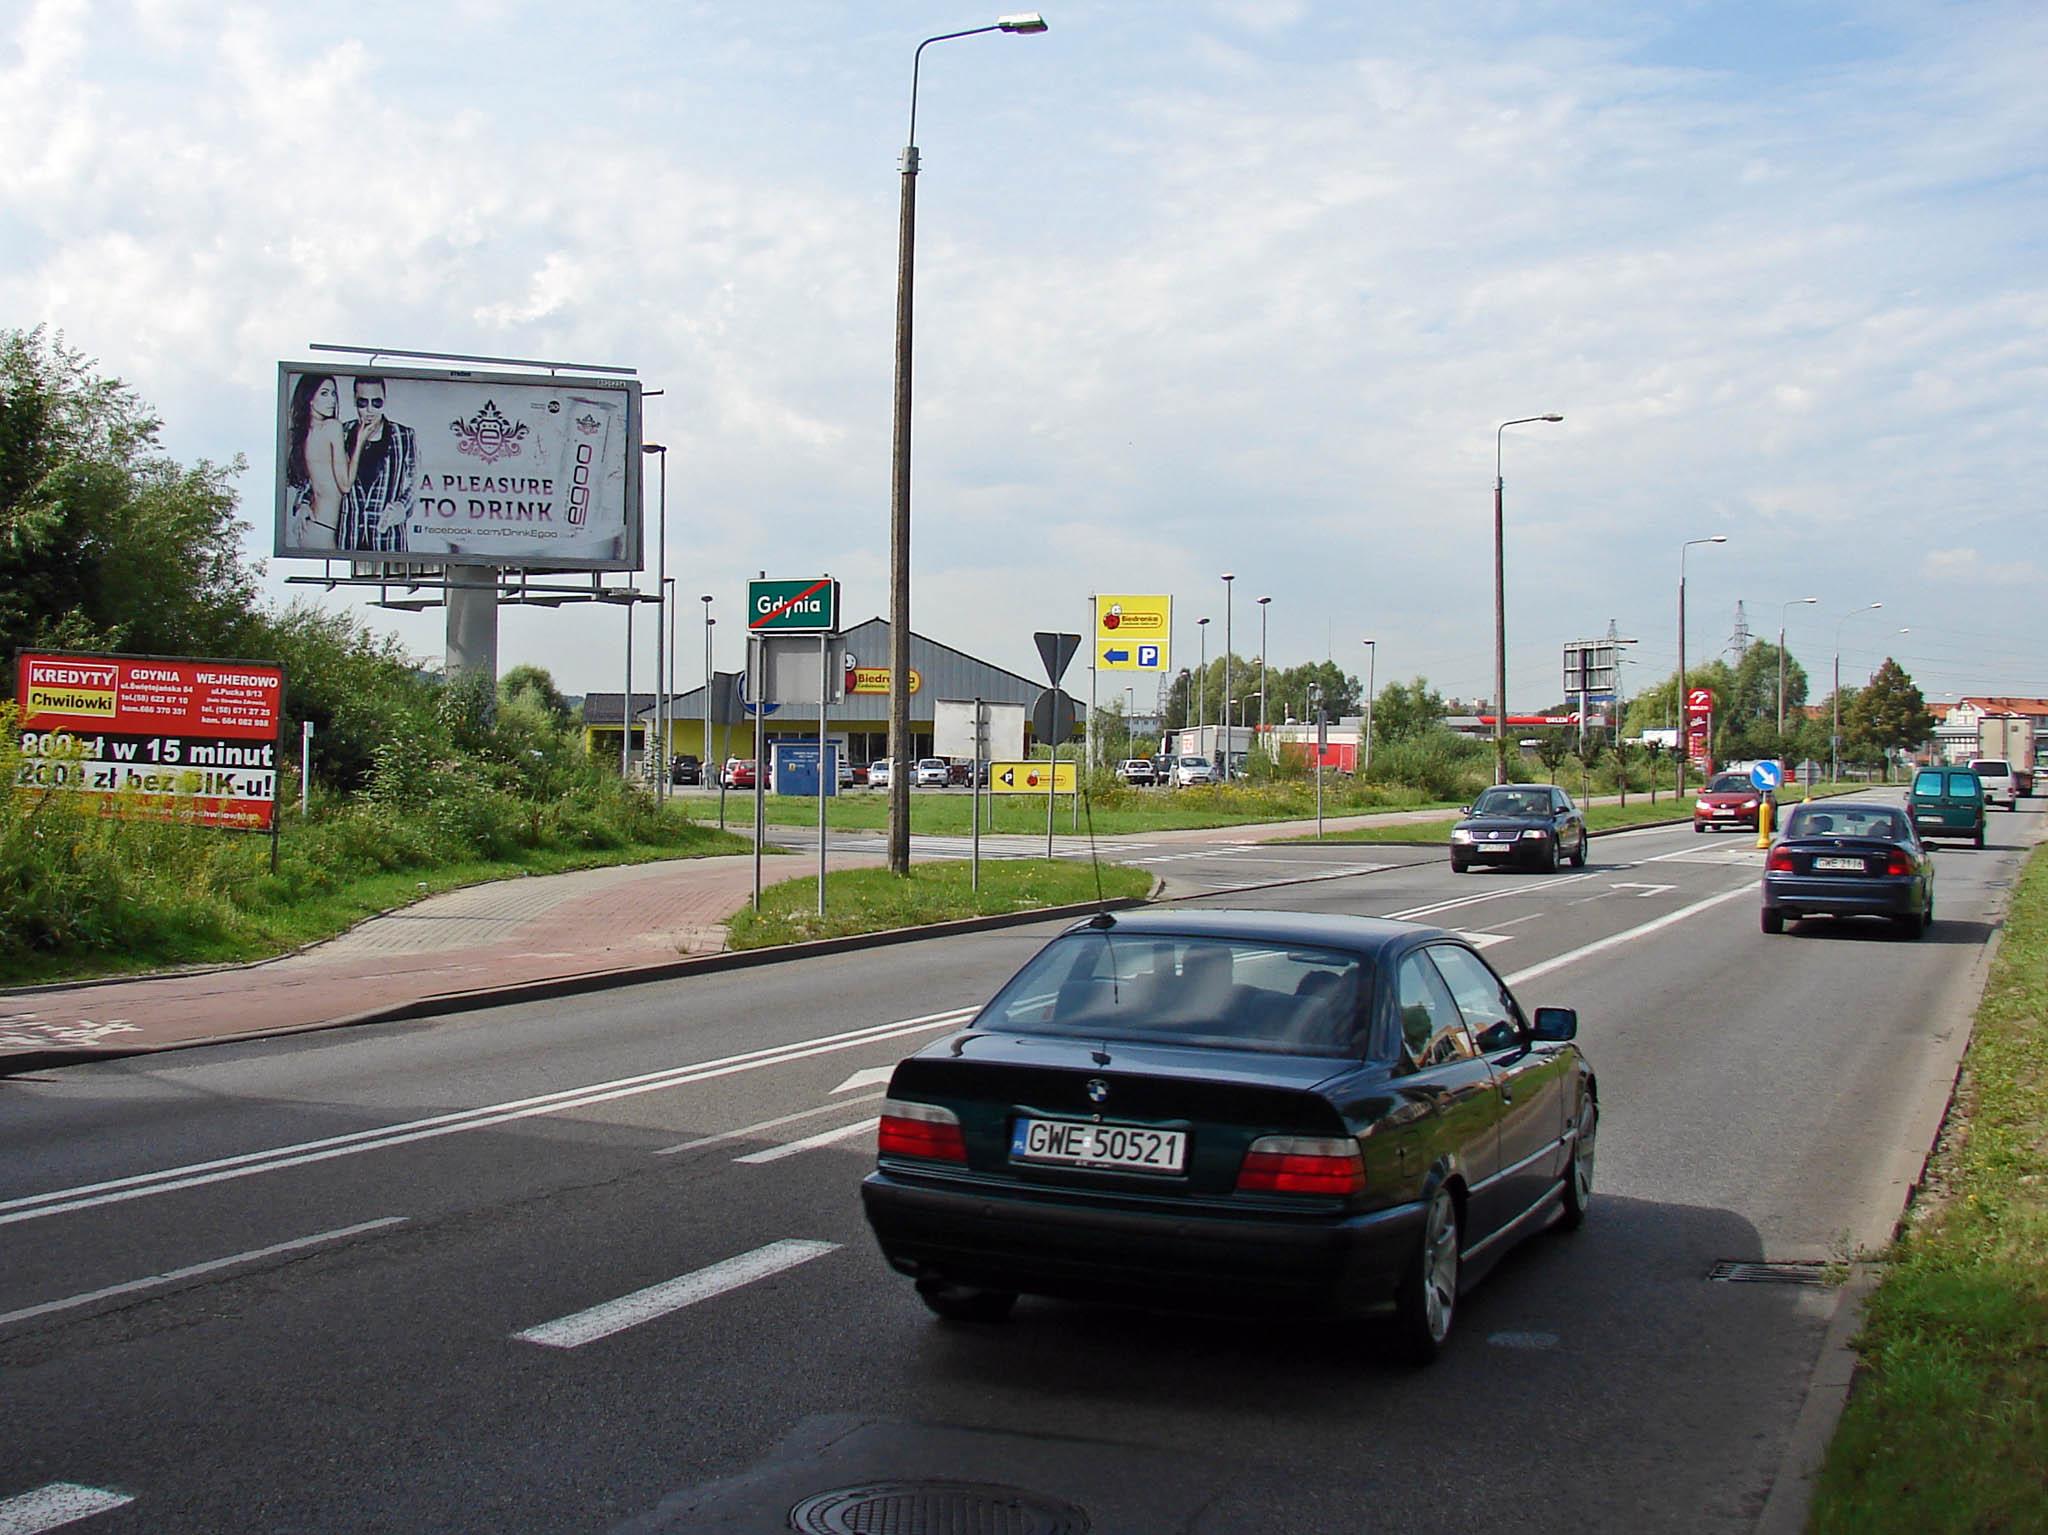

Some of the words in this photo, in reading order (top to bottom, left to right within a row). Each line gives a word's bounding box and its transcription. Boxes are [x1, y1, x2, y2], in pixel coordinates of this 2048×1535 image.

[420, 474, 433, 490] A
[443, 475, 553, 495] PLEASURE
[568, 444, 592, 525] egoo
[420, 498, 456, 518] TO
[468, 500, 552, 521] DRINK
[757, 596, 821, 618] Gdynia
[1142, 648, 1155, 664] P
[33, 668, 113, 686] KREDYTY
[131, 669, 180, 682] GDYNIA
[196, 672, 278, 688] WEJHEROWO
[858, 674, 915, 683] Biedra
[32, 693, 112, 710] Chwilówki
[22, 733, 72, 756] 800
[81, 736, 104, 759] zł
[112, 743, 138, 760] w
[147, 739, 181, 762] 15
[190, 742, 273, 766] minut
[17, 762, 86, 786] 200
[94, 768, 117, 788] zł
[184, 771, 272, 796] IK-u!
[1005, 774, 1013, 782] P
[1029, 1123, 1085, 1156] GWE
[1092, 1129, 1176, 1165] 50521
